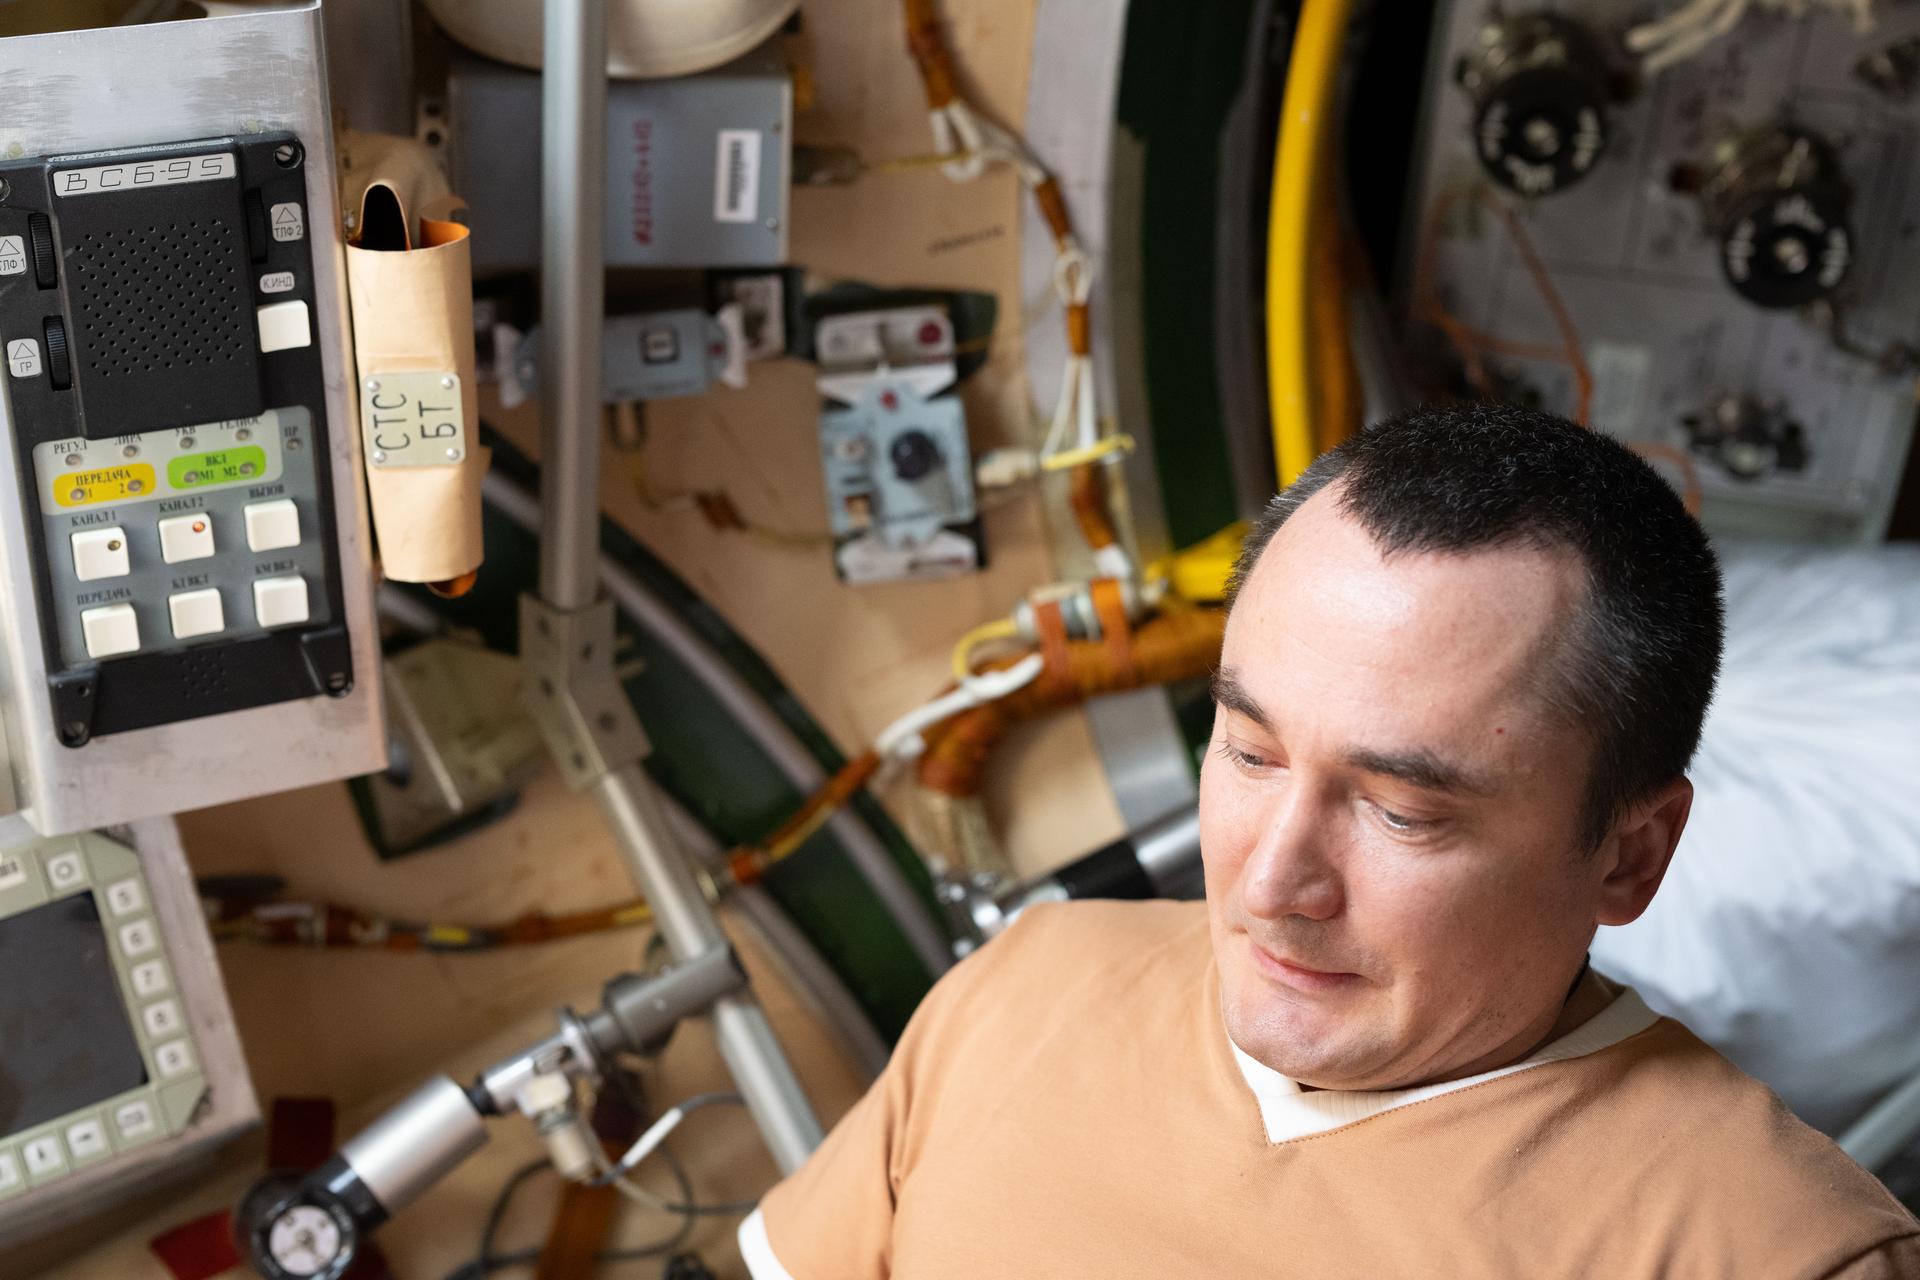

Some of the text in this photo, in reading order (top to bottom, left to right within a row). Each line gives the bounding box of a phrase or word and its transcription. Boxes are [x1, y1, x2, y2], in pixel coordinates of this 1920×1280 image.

[273, 225, 303, 238] ТЛФ 2
[21, 258, 26, 268] 1
[19, 362, 32, 373] ГР
[372, 393, 410, 451] СТС
[418, 400, 456, 439] БТ
[53, 440, 87, 454] РЕГУЛ
[204, 454, 228, 467] ВКЛ
[75, 469, 132, 486] ПЕРЕДАЧА
[200, 466, 237, 480] М1 М2
[88, 482, 125, 498] 1 2
[248, 484, 285, 498] ВЫЗОВ
[158, 496, 204, 513] КАНАЛ 2
[71, 510, 117, 526] КАНАЛ 1
[76, 587, 132, 605] ПЕРЕДАЧА
